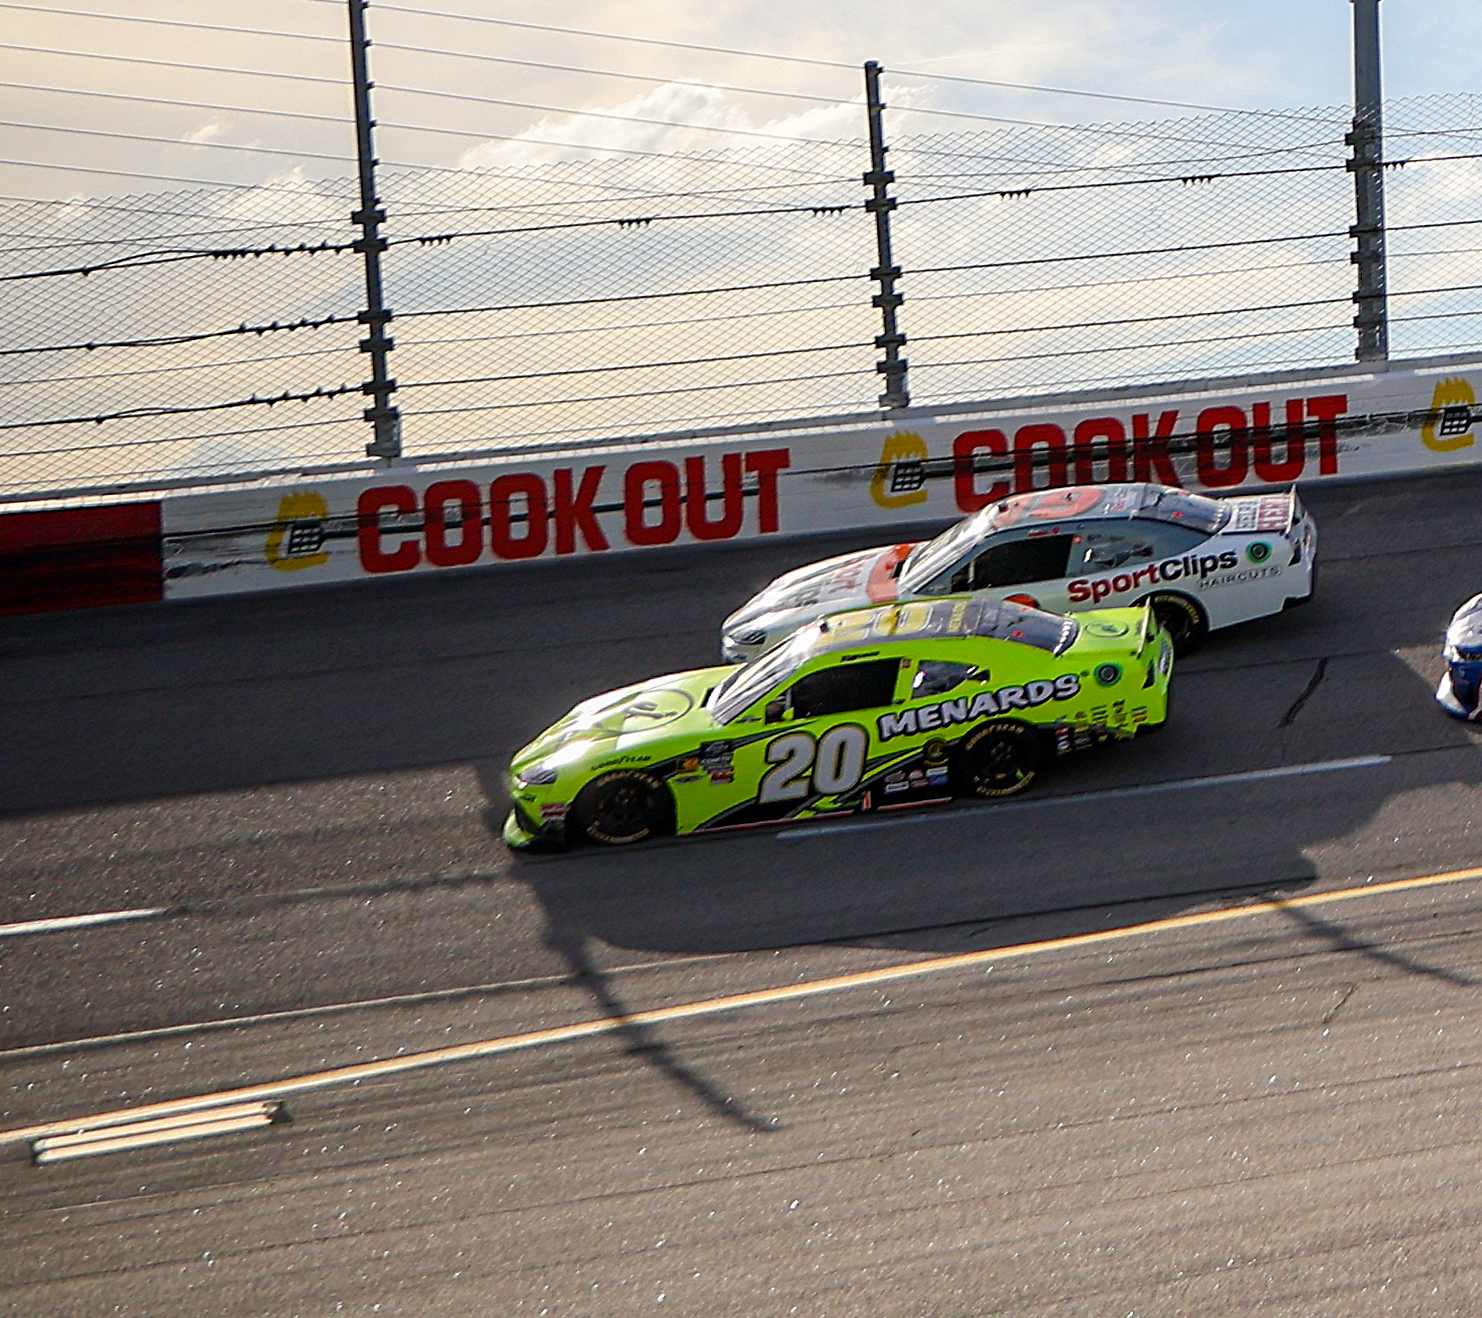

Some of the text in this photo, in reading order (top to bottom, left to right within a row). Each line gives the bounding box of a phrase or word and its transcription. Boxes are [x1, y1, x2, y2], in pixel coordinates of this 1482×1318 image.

[953, 394, 1348, 514] COOK OUT
[357, 447, 791, 575] COOK OUT
[1199, 564, 1282, 590] HAIRCUTS
[876, 672, 1082, 742] MENARDS
[757, 721, 869, 805] 20
